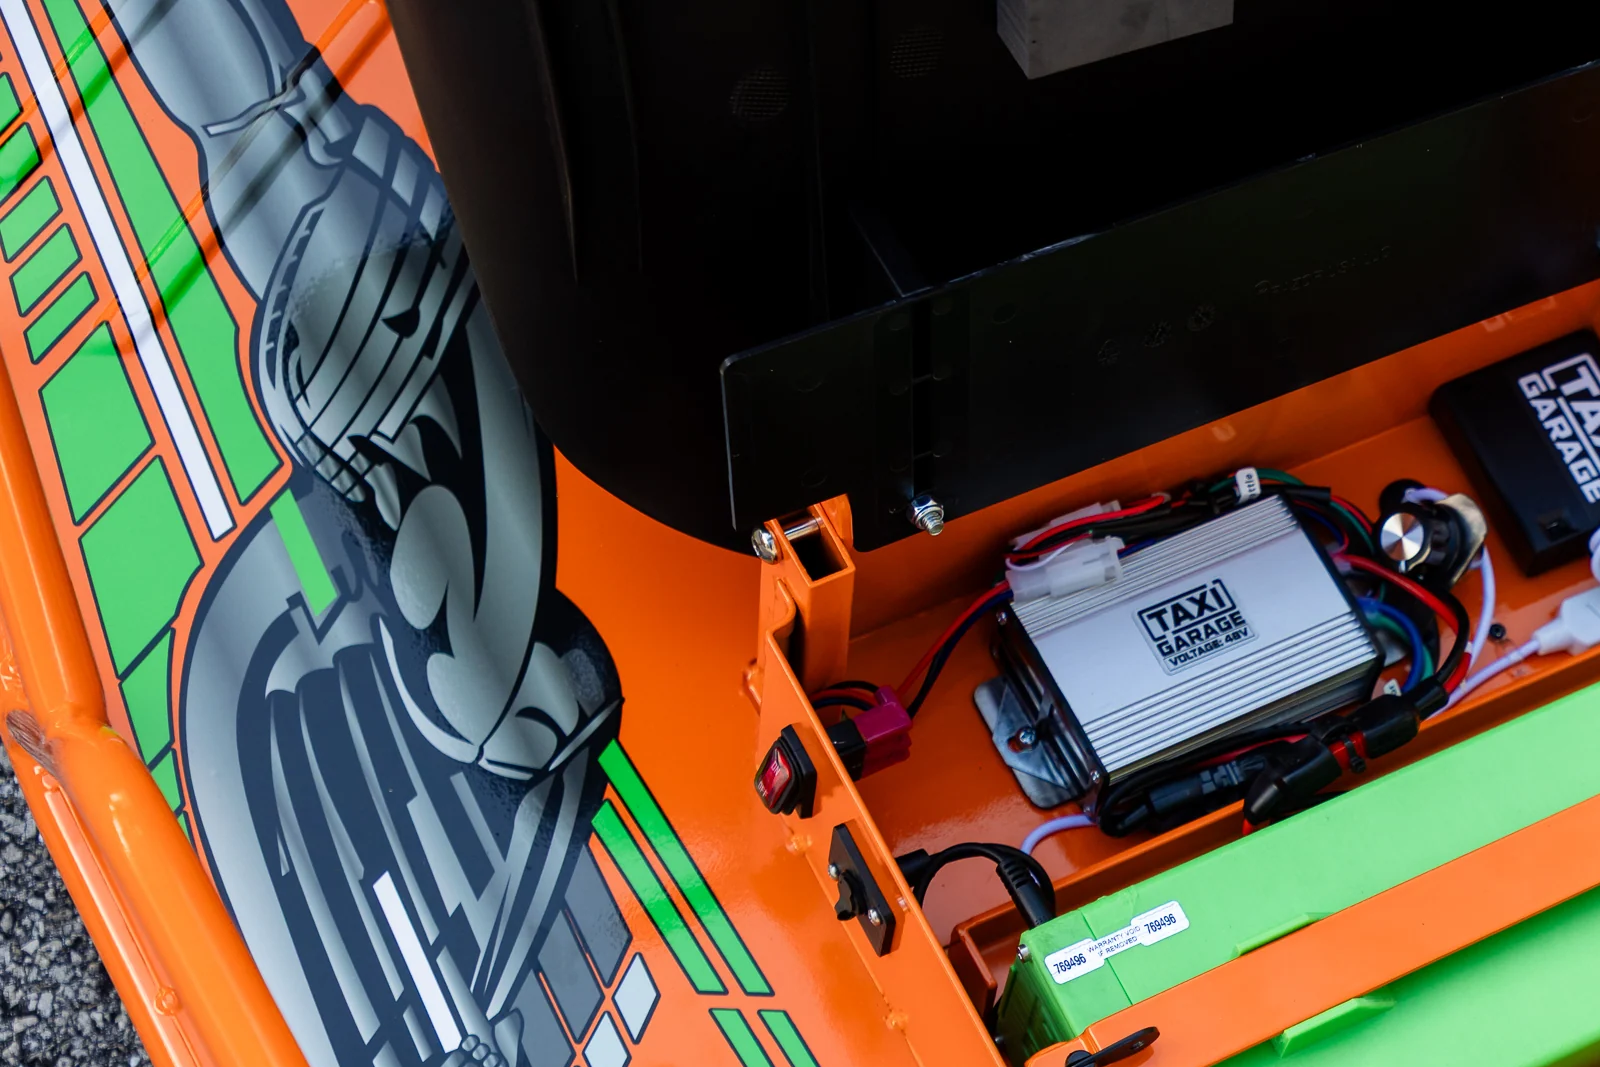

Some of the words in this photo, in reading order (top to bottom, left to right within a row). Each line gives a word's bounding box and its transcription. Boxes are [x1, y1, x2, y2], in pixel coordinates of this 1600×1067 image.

[1146, 587, 1226, 632] TAXI
[1156, 610, 1246, 657] GARAGE
[1169, 639, 1225, 666] VOLTAGE:
[1225, 627, 1248, 643] 48V
[770, 760, 781, 776] ON
[1144, 913, 1177, 934] 769496
[1087, 932, 1124, 953] WARRANTY
[1125, 925, 1141, 936] VOID
[1105, 935, 1138, 954] REMOVED
[1053, 953, 1087, 974] 769496
